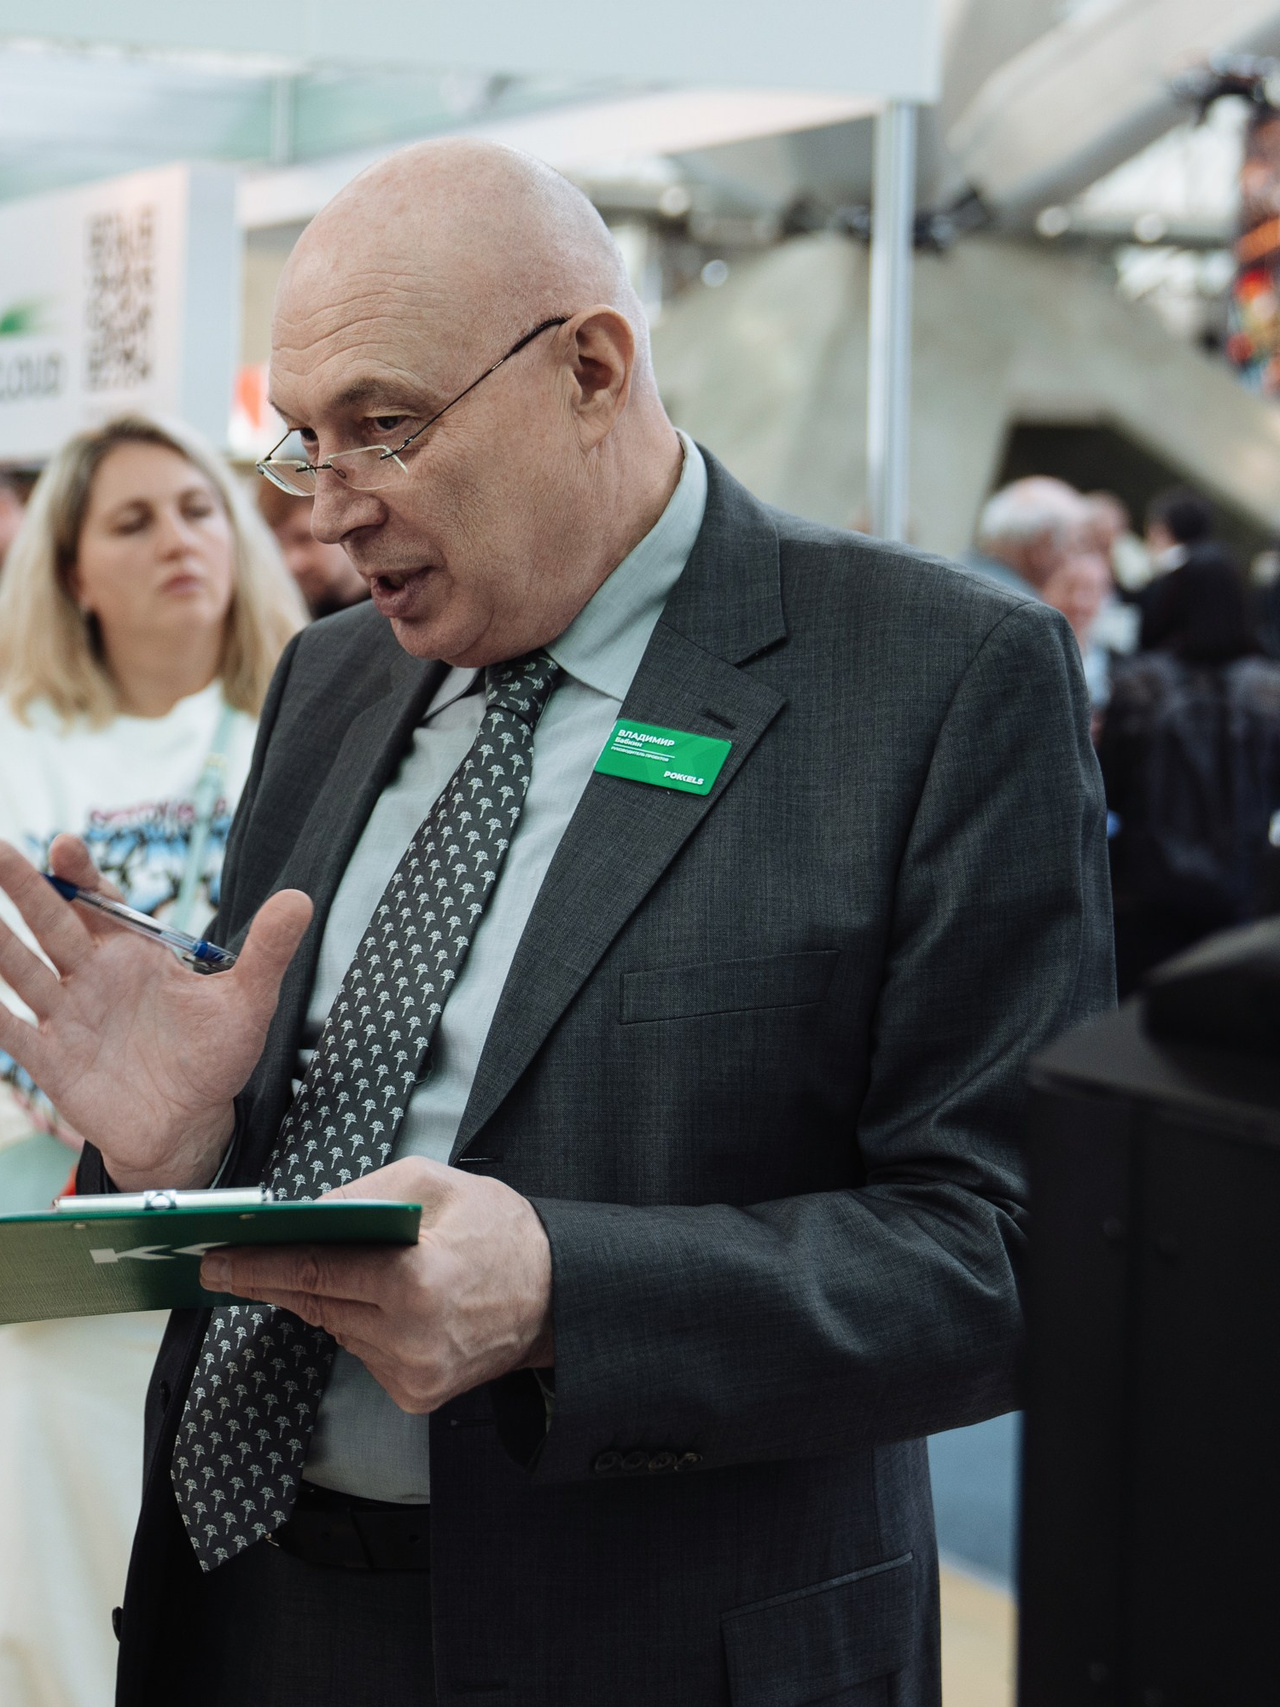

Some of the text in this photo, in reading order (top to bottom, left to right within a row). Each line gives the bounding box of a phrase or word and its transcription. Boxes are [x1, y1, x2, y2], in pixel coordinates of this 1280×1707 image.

[615, 736, 643, 748] Бабкин
[618, 729, 675, 747] ВЛАДИМИР
[663, 770, 704, 785] POKKELS
